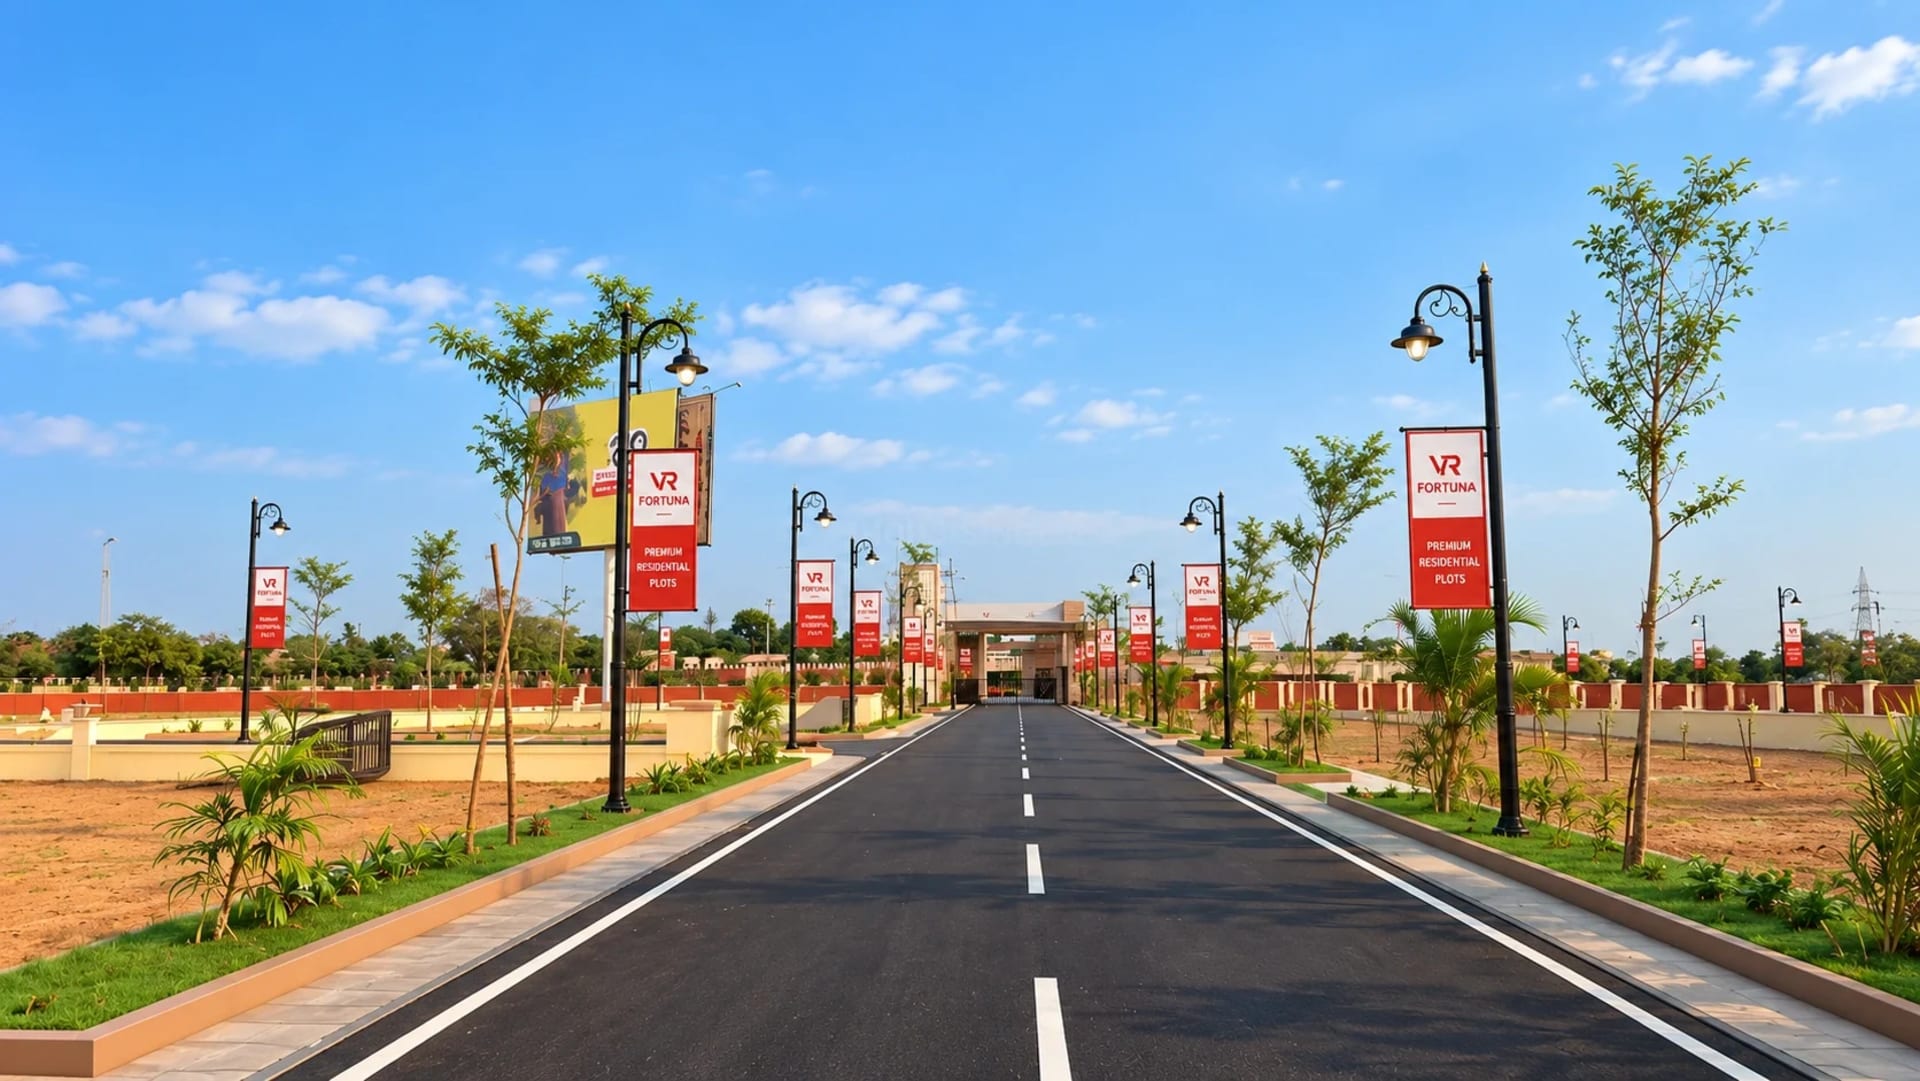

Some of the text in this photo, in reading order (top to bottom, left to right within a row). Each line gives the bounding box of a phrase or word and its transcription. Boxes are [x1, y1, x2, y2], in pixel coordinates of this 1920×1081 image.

[1429, 455, 1461, 476] VR
[650, 472, 678, 491] VR
[1417, 482, 1477, 494] FORTUNA
[638, 496, 690, 506] FORTUNA
[1427, 541, 1471, 550] PREMIUM
[644, 547, 683, 557] PREMIUM
[636, 562, 690, 572] RESIDENTIAL
[1419, 557, 1480, 567] RESIDENTIAL
[807, 572, 823, 583] VR
[1194, 576, 1210, 586] VR
[1435, 574, 1466, 584] PLOTS
[263, 578, 276, 588] VR
[650, 578, 677, 588] PLOTS
